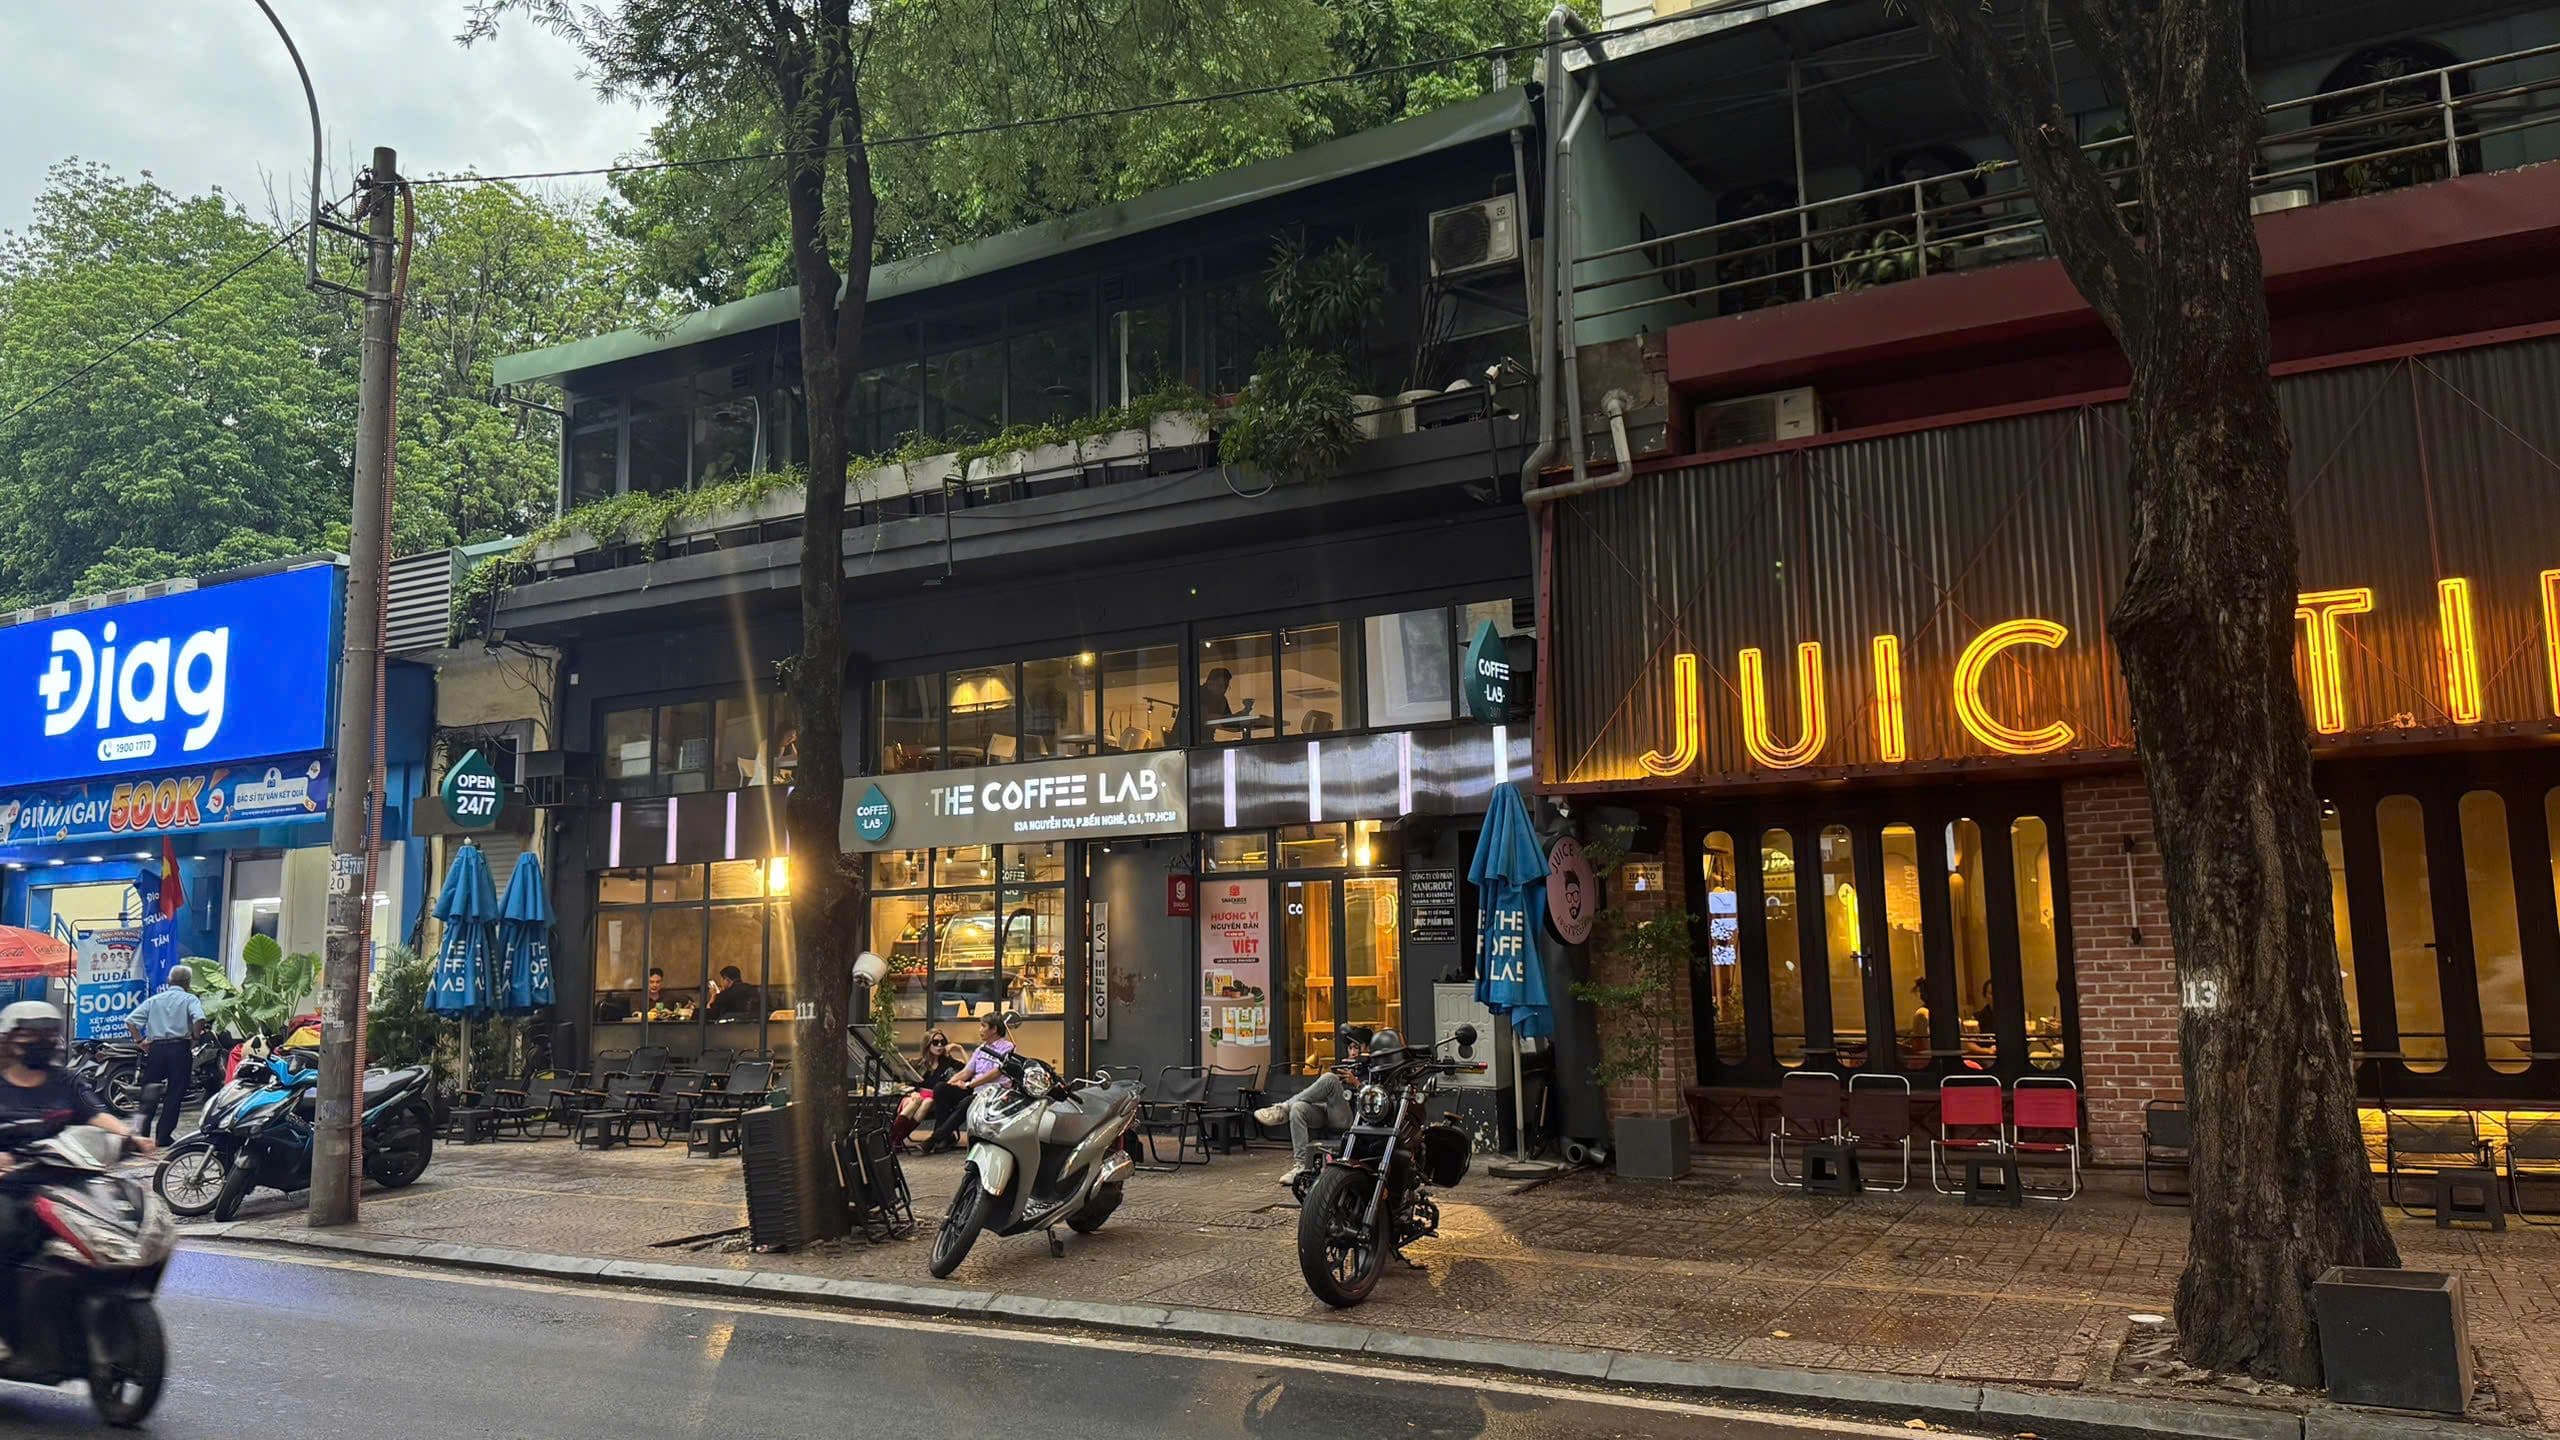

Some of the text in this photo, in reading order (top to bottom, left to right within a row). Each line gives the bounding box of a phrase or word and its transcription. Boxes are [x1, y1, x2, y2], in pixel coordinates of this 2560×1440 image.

[1478, 658, 1510, 681] COFFEE
[1639, 570, 2560, 778] JUIC TI
[1486, 683, 1504, 703] LAB
[457, 774, 496, 790] OPEN
[930, 769, 1159, 817] THE COFFEE LAB
[109, 776, 206, 833] 500K
[456, 796, 496, 816] 24/7
[857, 804, 889, 817] COFFEE
[863, 818, 881, 829] LAB
[1551, 843, 1574, 874] JUICE
[1095, 922, 1106, 1018] COFFEE LAB
[79, 990, 142, 1014] 500K
[796, 1001, 817, 1020] 111
